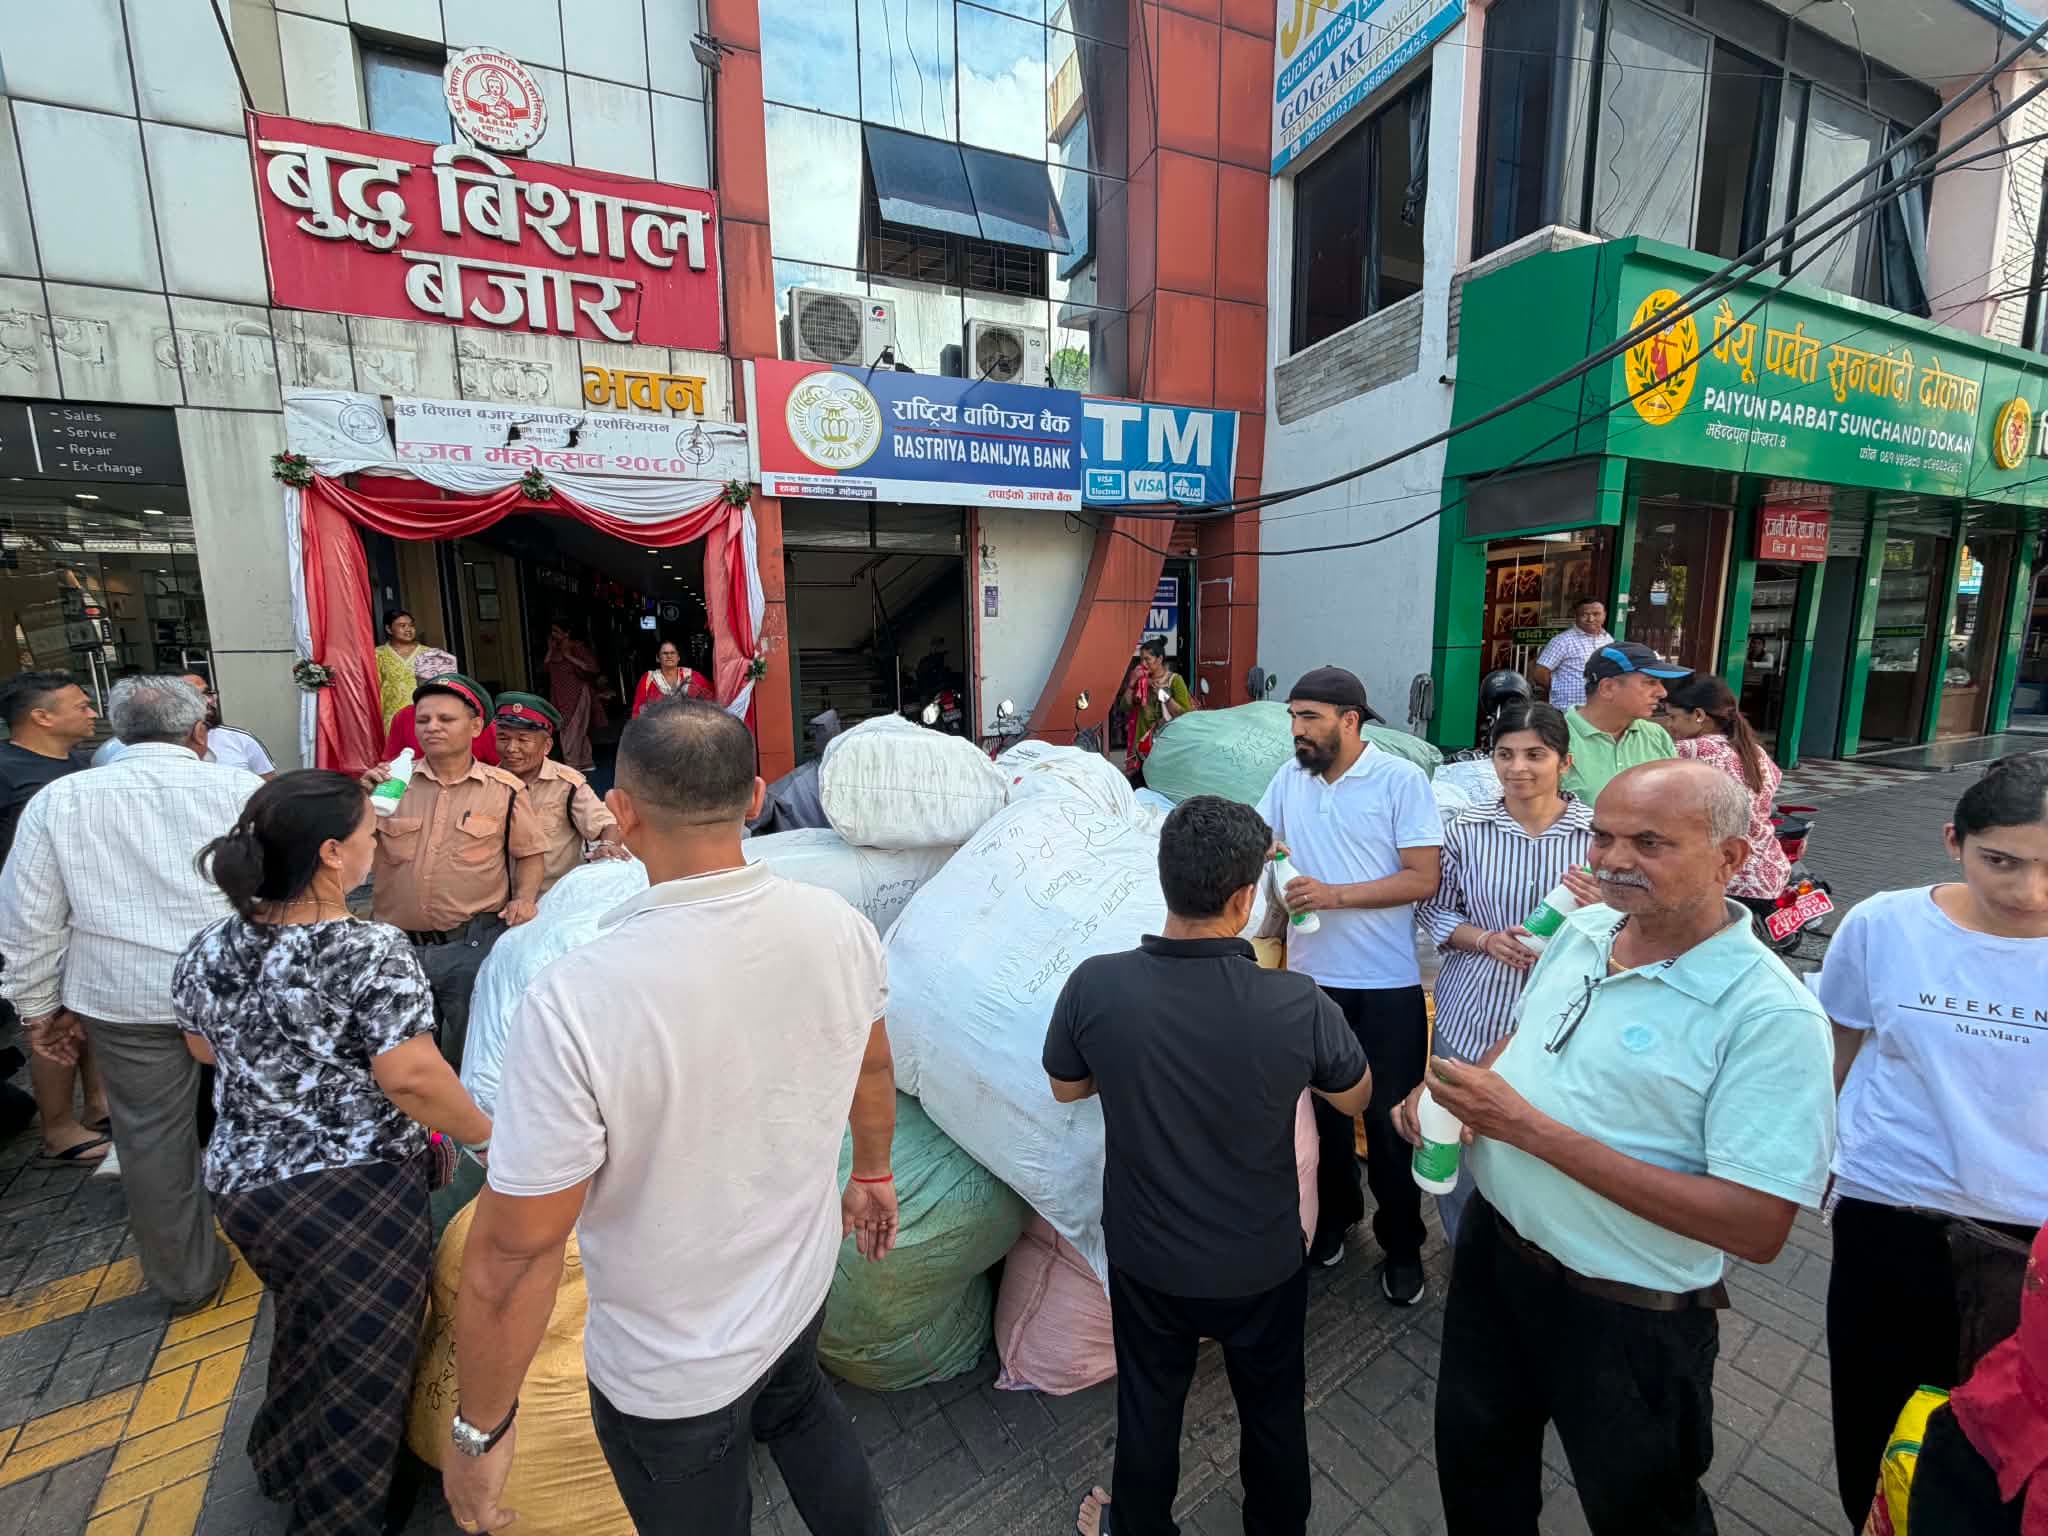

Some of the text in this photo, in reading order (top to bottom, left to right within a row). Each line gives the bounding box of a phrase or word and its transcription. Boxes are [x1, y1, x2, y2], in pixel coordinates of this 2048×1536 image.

[1280, 40, 1323, 93] SUDENT
[1325, 14, 1353, 49] VISA
[1281, 24, 1373, 129] GOGAKU
[1282, 93, 1337, 146] TRAINING
[1340, 38, 1395, 95] CENTER
[258, 140, 710, 271] बुद्ध बिशाल
[402, 249, 637, 342] बजार
[1765, 321, 1822, 385] पर्वत
[1919, 356, 1980, 416] दोकान
[583, 365, 707, 415] भवन
[64, 409, 102, 423] Sales
[476, 408, 514, 421] बजार
[963, 402, 1036, 431] वाणिज्य
[1703, 387, 1973, 455] PAIYUN PARBAT SUNCHANDI DOKAN
[67, 427, 118, 441] Service
[1081, 402, 1214, 467] TM
[70, 444, 113, 457] Repair
[398, 441, 473, 463] रजत
[893, 434, 1072, 470] RASTRIYA BANIJYA BANK
[73, 461, 143, 476] Ex-change
[1133, 478, 1164, 493] VISA
[1181, 485, 1201, 497] PLUS
[1955, 1023, 2031, 1045] MaxMara
